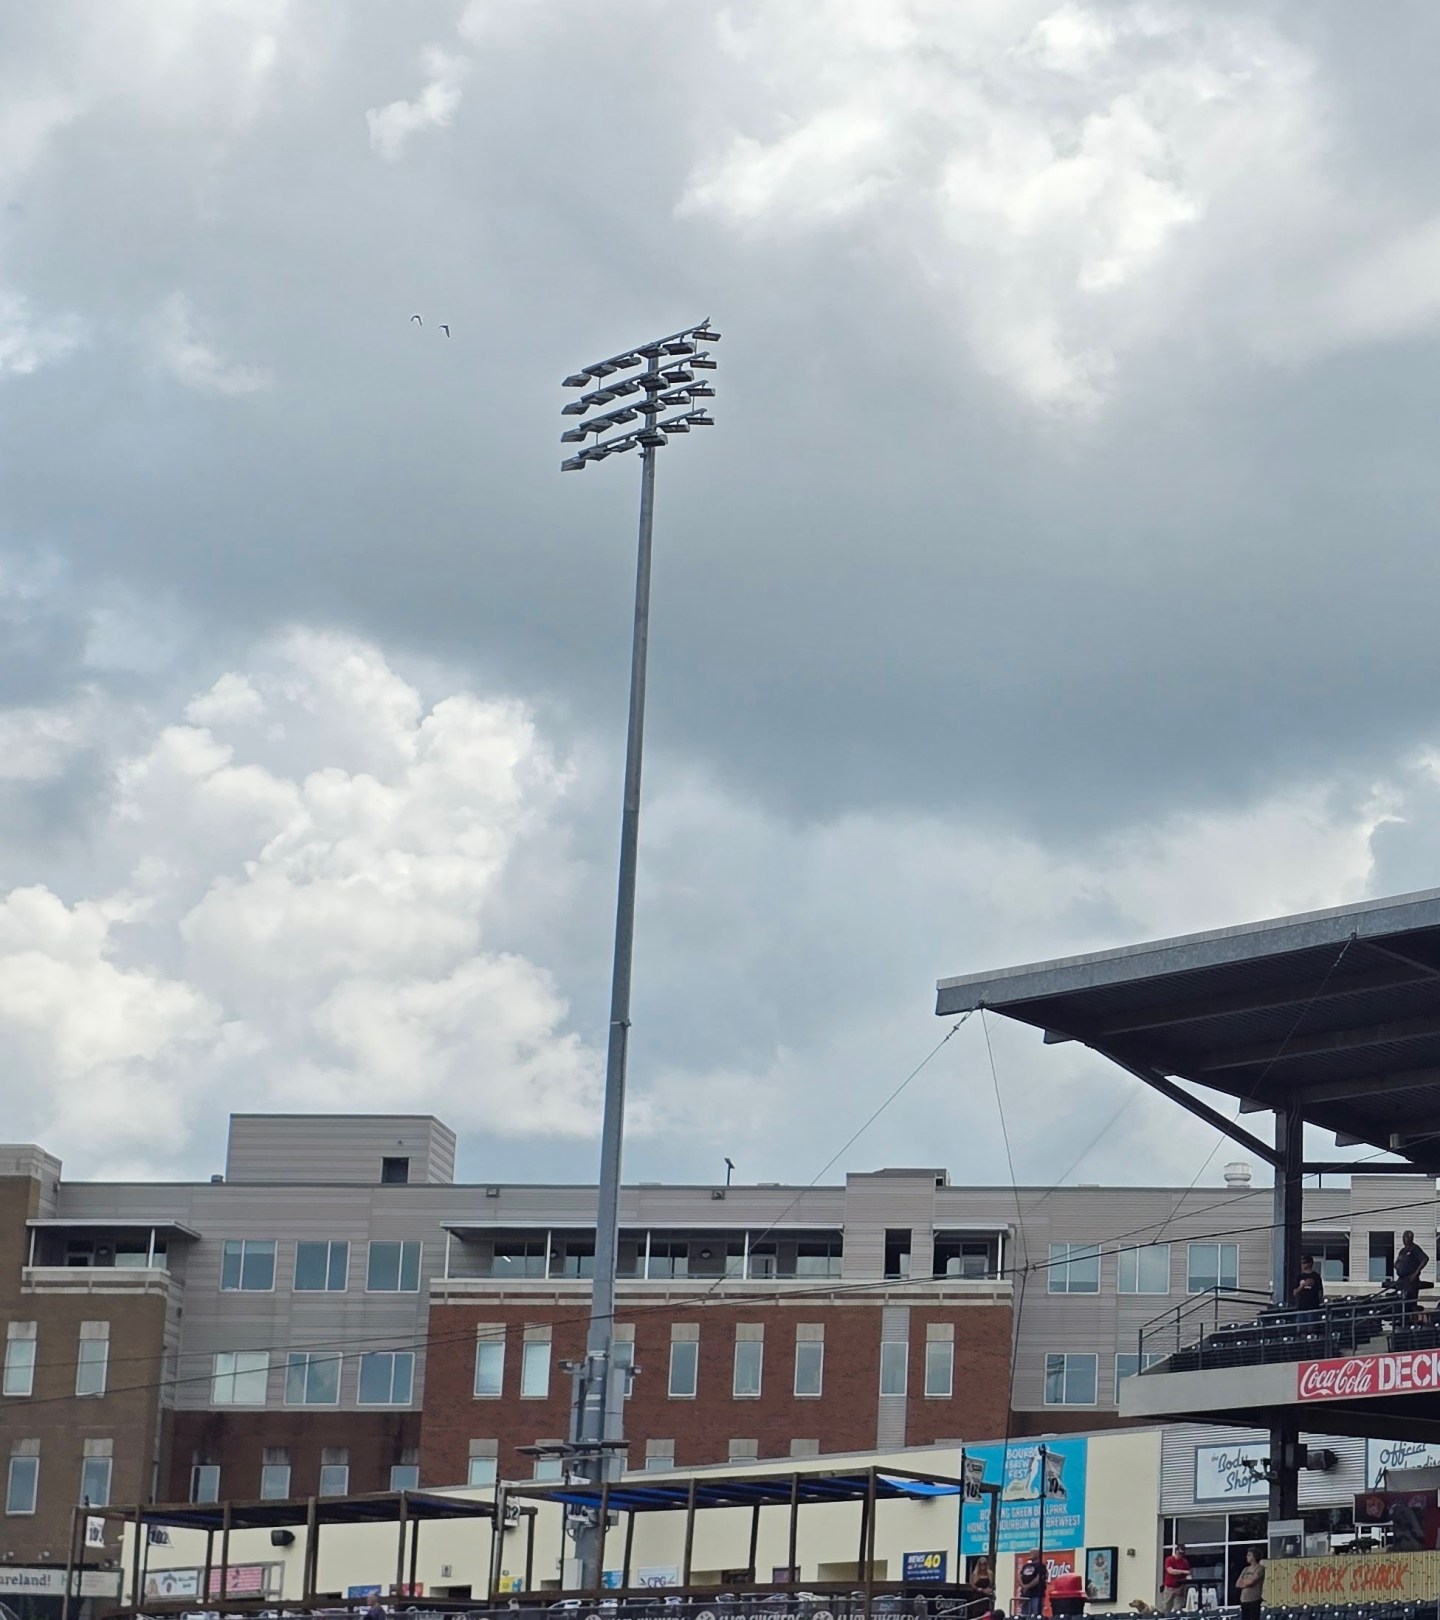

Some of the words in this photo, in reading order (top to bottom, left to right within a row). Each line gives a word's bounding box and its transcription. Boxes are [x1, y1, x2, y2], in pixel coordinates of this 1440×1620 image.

[1300, 1357, 1376, 1397] Coca-Cola
[1224, 1470, 1259, 1493] Shop
[923, 1554, 941, 1569] 40
[1292, 1562, 1348, 1594] SNACK
[1350, 1560, 1411, 1592] SHACK
